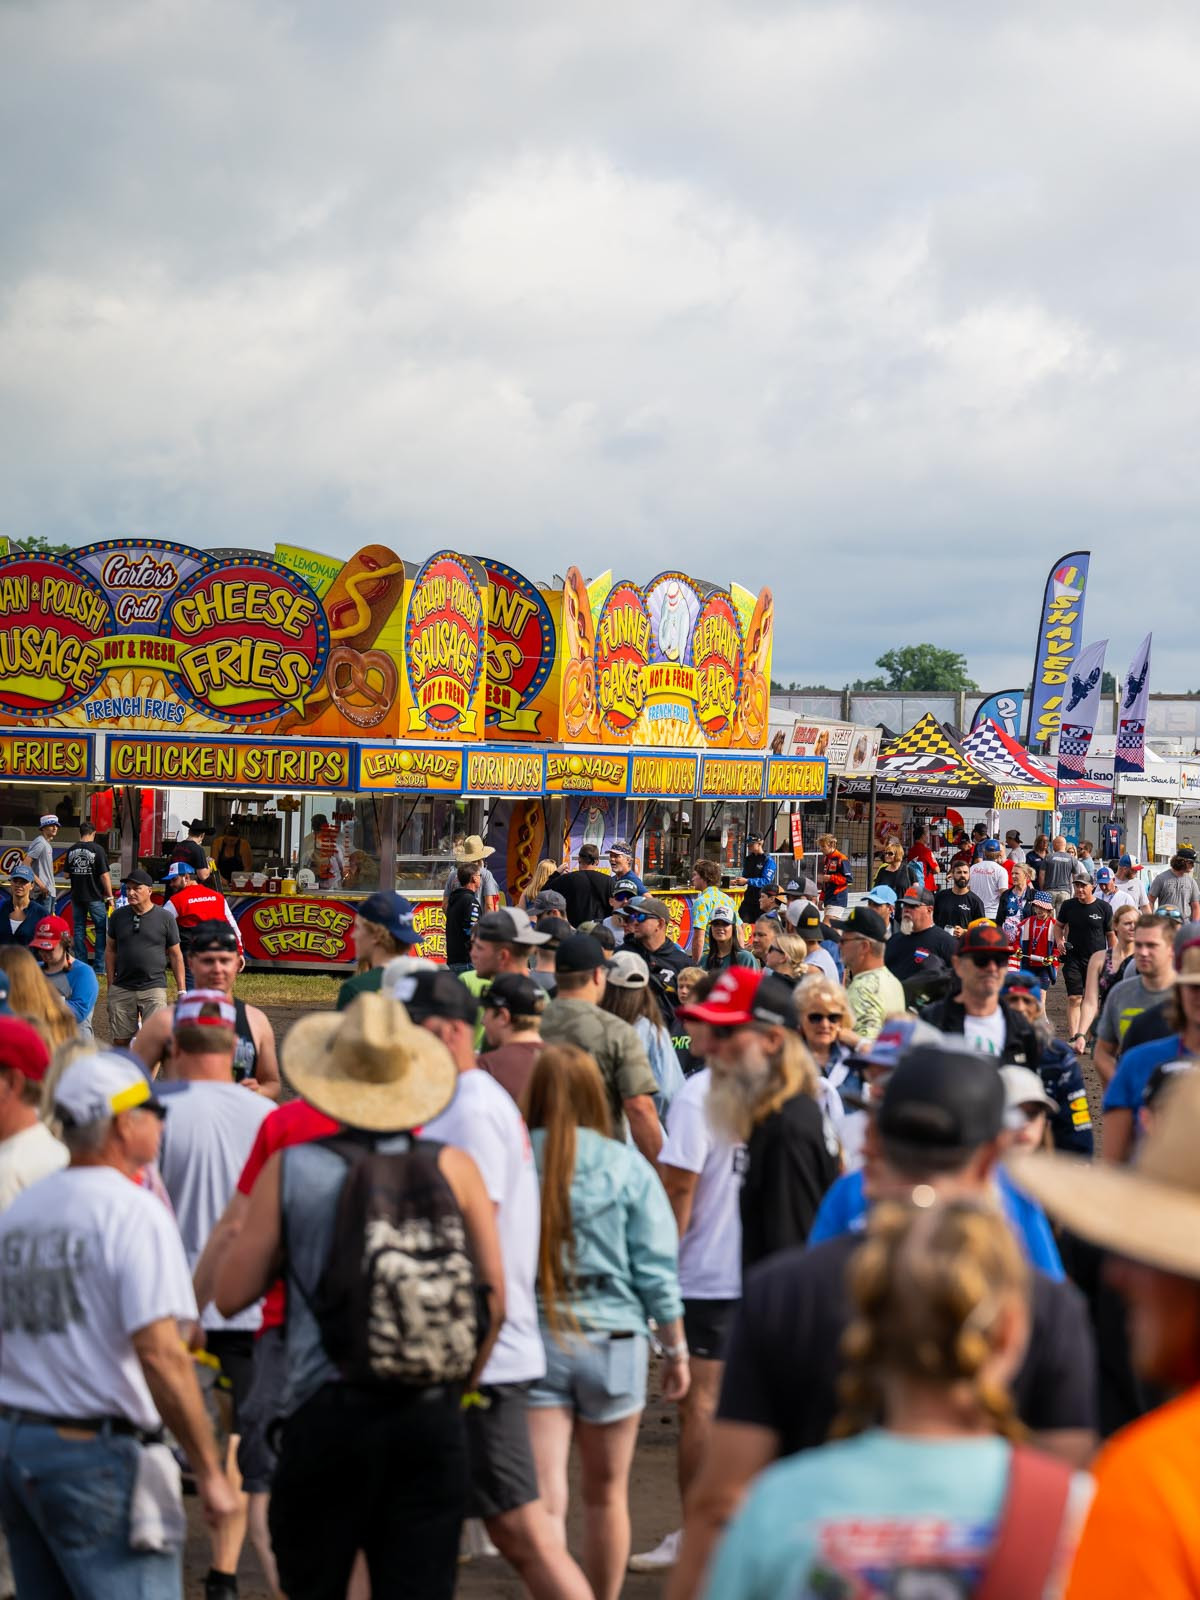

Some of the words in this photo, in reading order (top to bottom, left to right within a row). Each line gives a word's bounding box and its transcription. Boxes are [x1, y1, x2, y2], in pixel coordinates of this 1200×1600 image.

[104, 554, 176, 587] Carter's
[43, 577, 108, 633] POLISH
[118, 595, 160, 623] Grill
[172, 581, 317, 636] CHEESE
[411, 576, 446, 624] ITALIAN
[451, 577, 481, 631] POLISH
[602, 604, 651, 666] FUNNEL
[692, 613, 742, 672] ELEPHANT
[1041, 595, 1080, 685] SHAVED
[104, 641, 126, 661] HOT
[139, 640, 176, 665] FRESH
[179, 636, 312, 697] FRIES
[412, 620, 478, 689] SAUSAGE
[422, 682, 437, 708] HOT
[444, 682, 465, 709] FRESH
[600, 659, 648, 711] CAKES
[649, 668, 664, 689] HOT
[672, 669, 694, 692] FRESH
[697, 664, 736, 712] EARS
[85, 697, 141, 722] FRENCH
[144, 698, 186, 725] FRIES
[13, 741, 82, 773] FRIES
[117, 743, 234, 780] CHICKEN
[243, 747, 344, 784] STRIPS
[470, 755, 503, 788] CORN
[507, 756, 540, 790] DOGS
[404, 774, 427, 788] SODA
[571, 778, 592, 790] SODA
[633, 759, 664, 793] CORN
[666, 759, 695, 793] DOGS
[702, 764, 741, 794] ELEPHANT
[741, 764, 763, 795] EARS
[769, 763, 823, 794] PRETZELS
[1094, 771, 1114, 781] sno
[188, 895, 217, 905] GASGAS
[254, 903, 353, 936] CHEESE
[261, 931, 345, 958] FRIES
